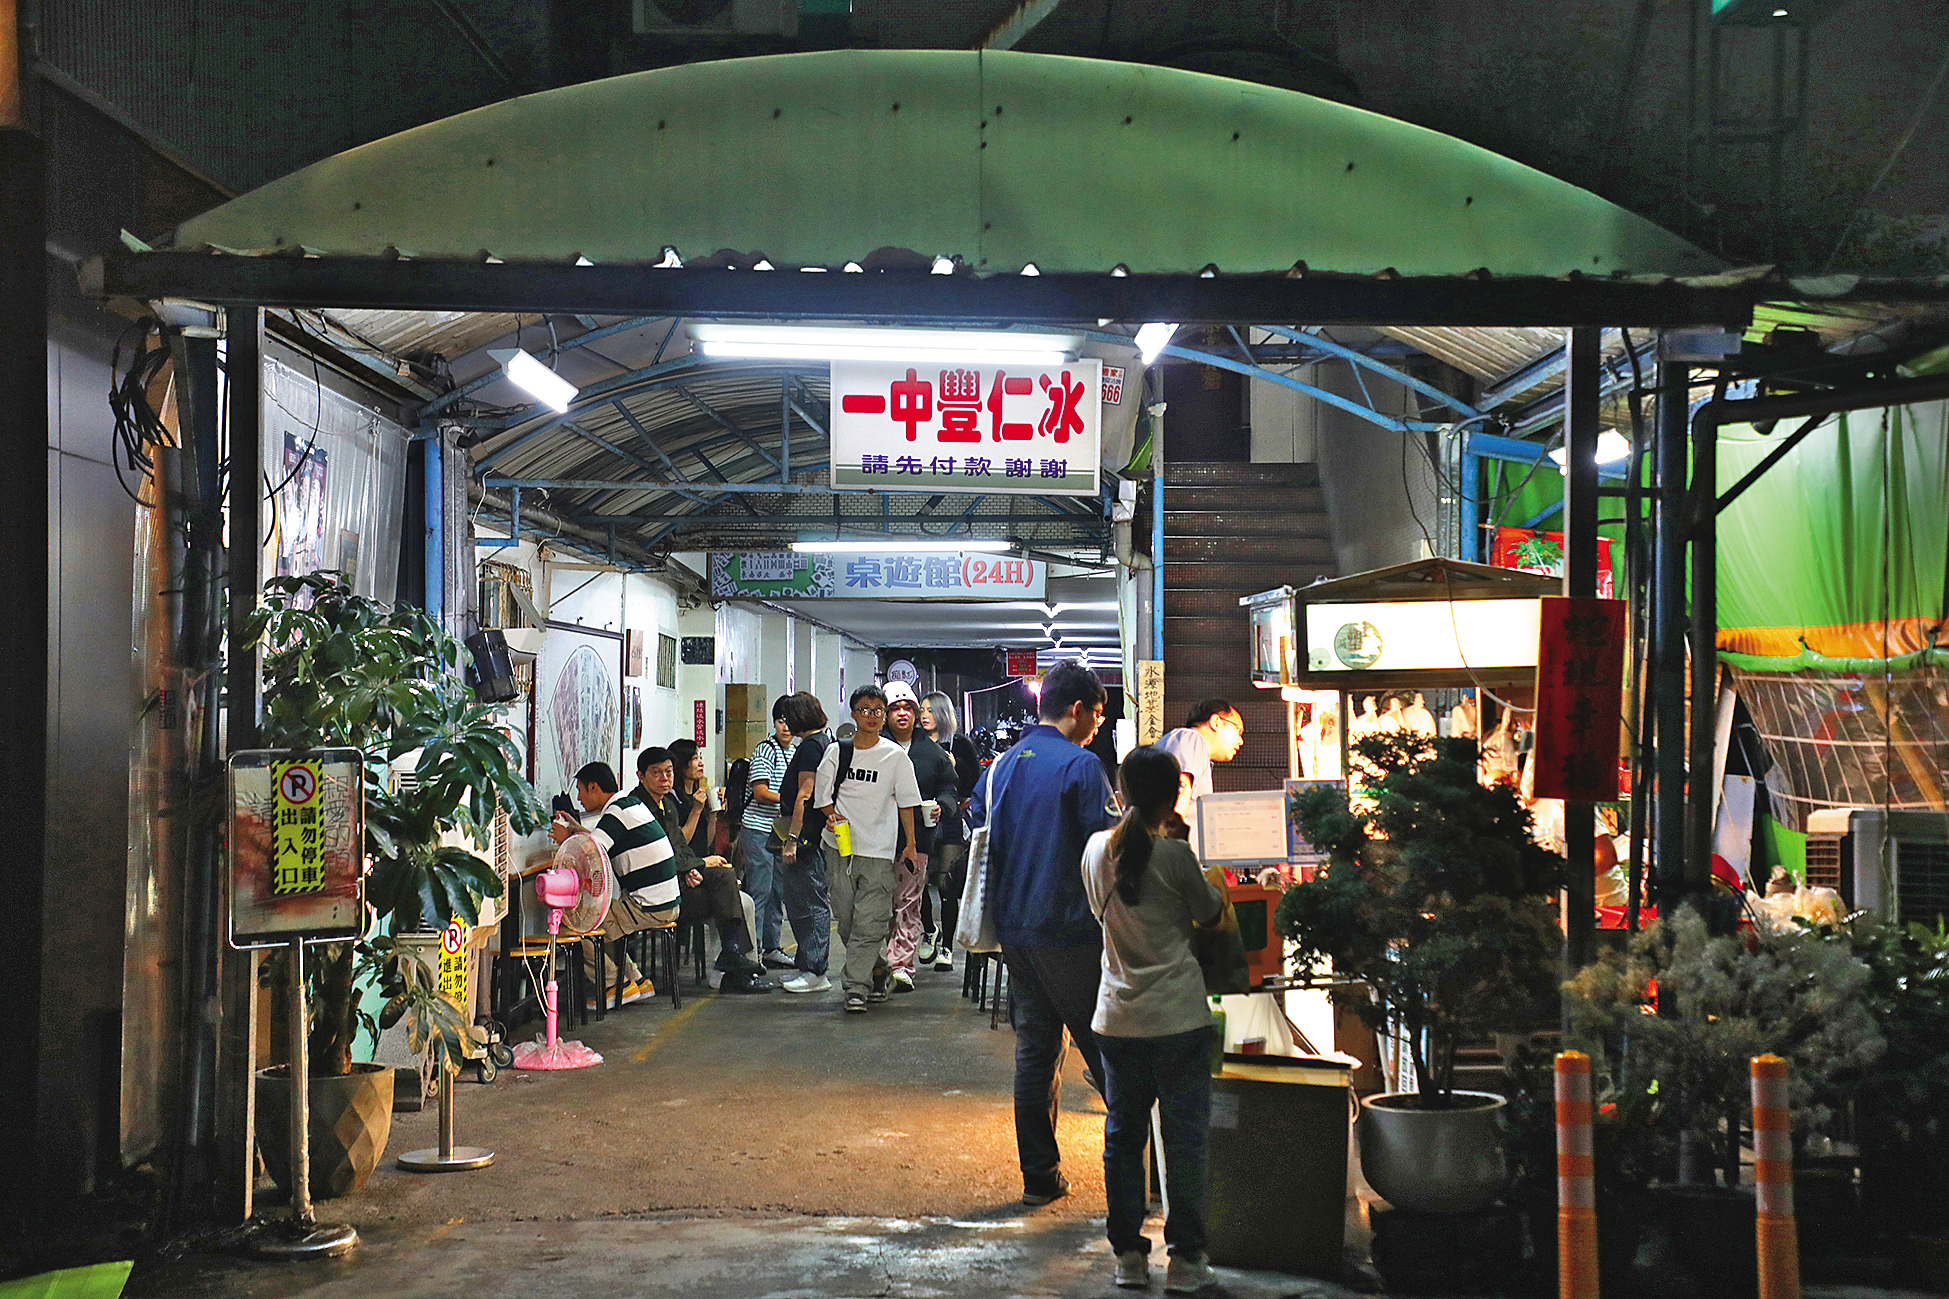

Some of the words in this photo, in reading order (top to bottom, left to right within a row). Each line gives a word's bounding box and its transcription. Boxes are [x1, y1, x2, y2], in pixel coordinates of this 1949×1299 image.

[842, 367, 1085, 444] 一中豐仁冰
[861, 454, 992, 477] 請先付款
[1005, 458, 1068, 479] 謝謝
[845, 556, 1033, 588] 桌遊館(24H)
[281, 808, 298, 885] 出入口
[300, 807, 317, 884] 請勿停車
